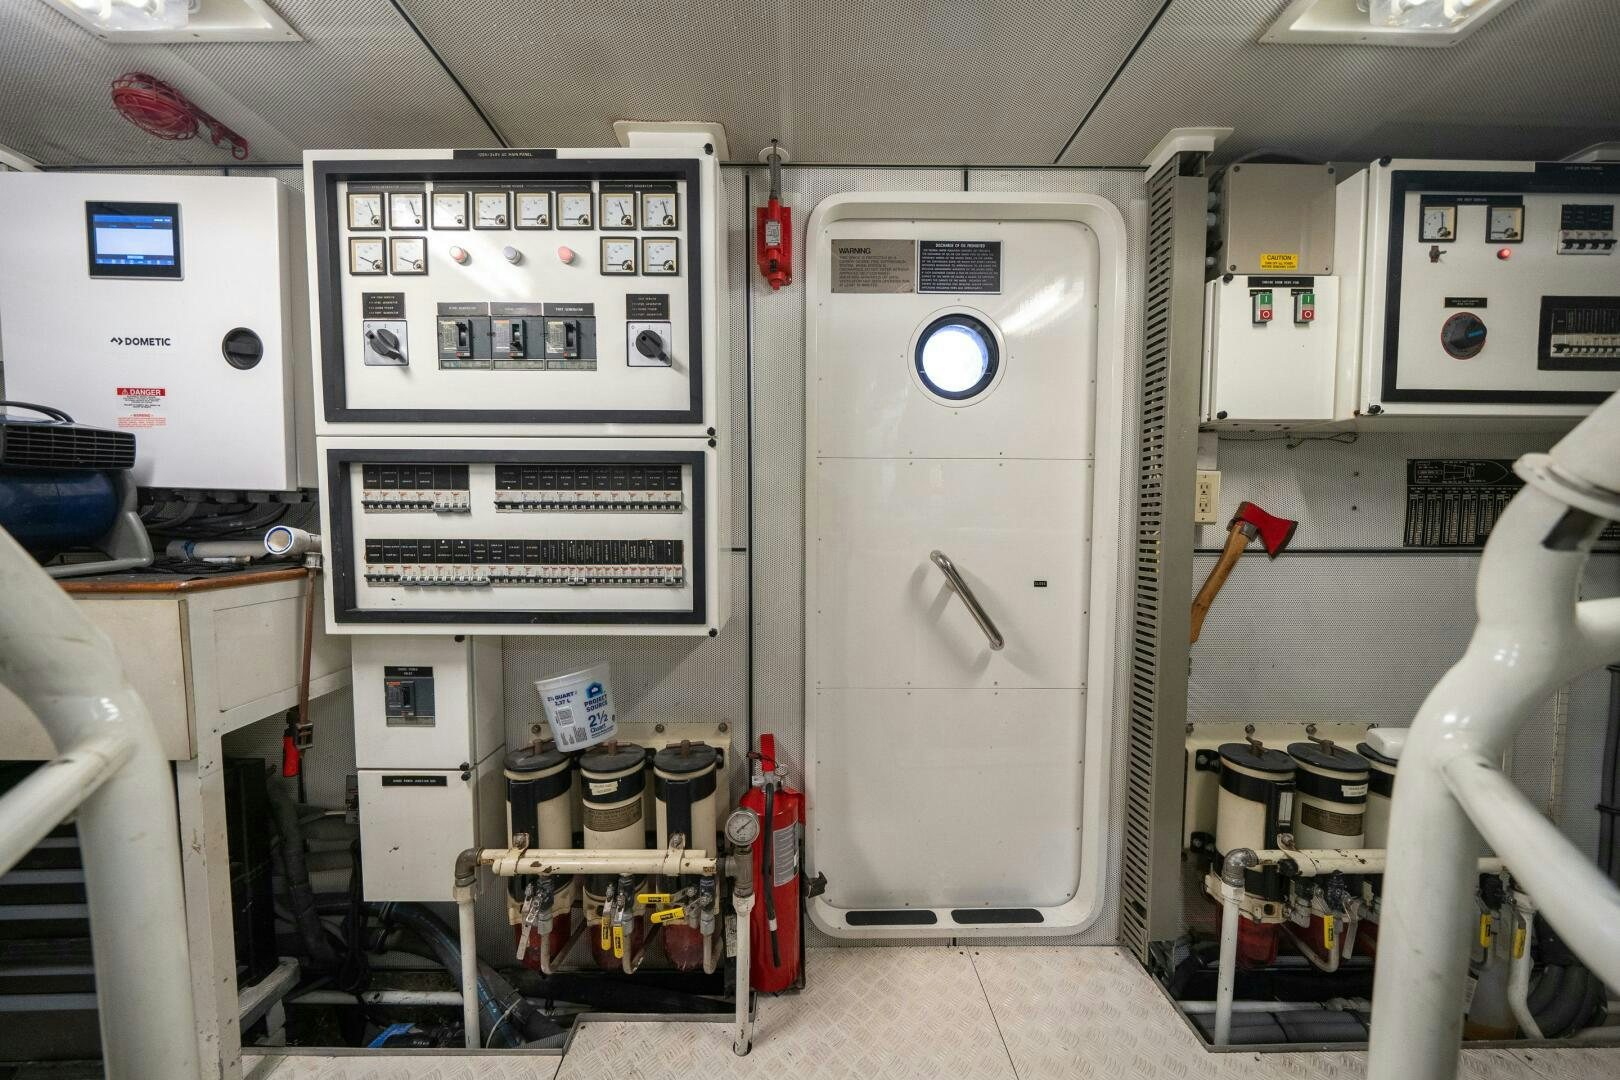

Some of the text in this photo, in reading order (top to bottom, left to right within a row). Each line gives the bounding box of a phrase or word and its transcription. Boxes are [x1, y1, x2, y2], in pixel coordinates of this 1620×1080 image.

[838, 247, 871, 255] WARNING
[125, 337, 171, 346] DOMETIC
[130, 388, 161, 396] DANGER
[554, 691, 574, 700] QUART
[584, 693, 608, 708] PROJECT
[586, 701, 608, 713] SOURCE
[588, 710, 609, 728] 2½
[590, 723, 607, 733] Quart
